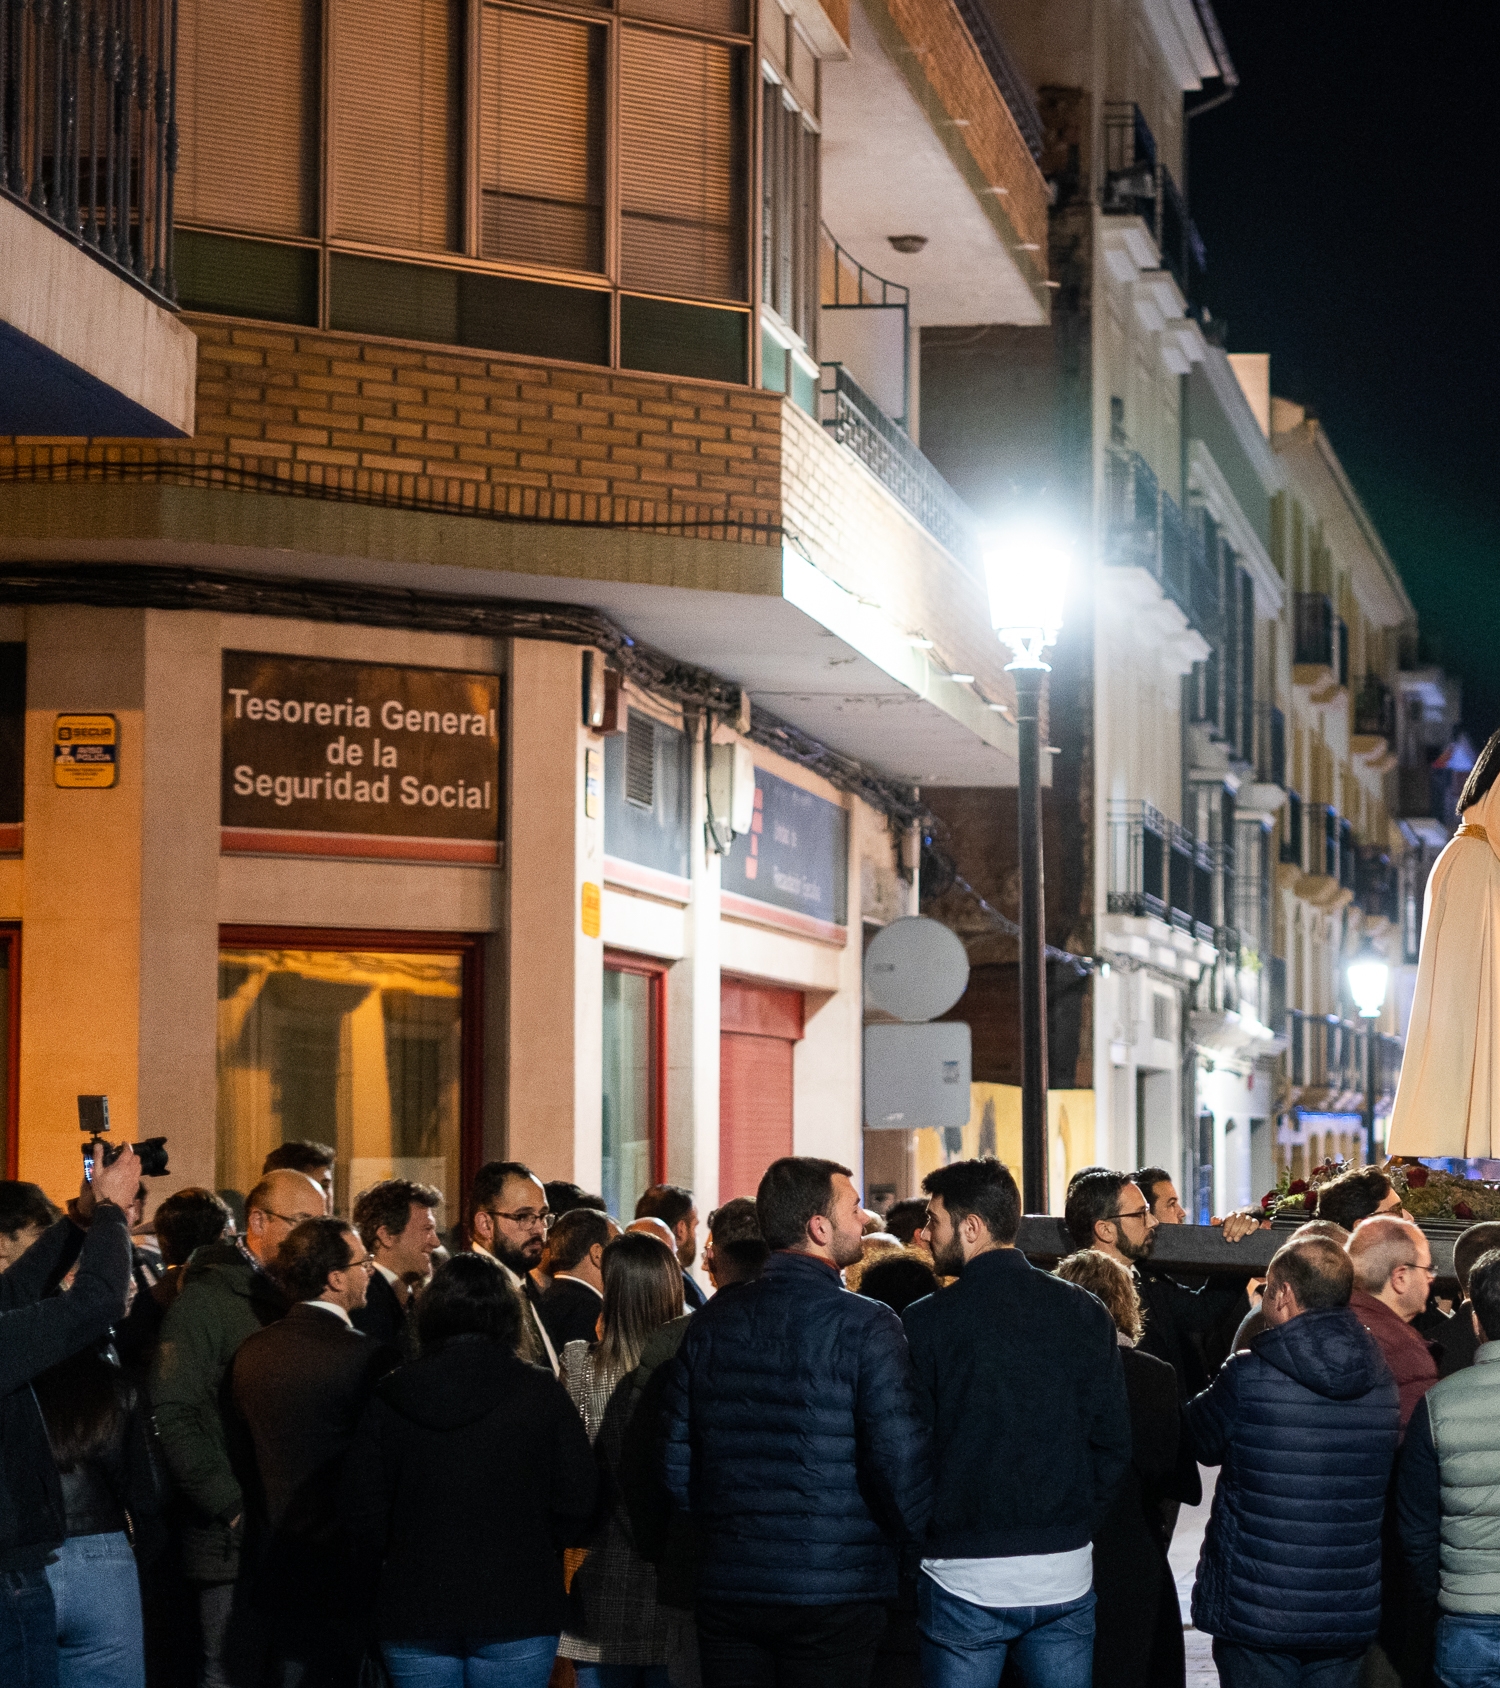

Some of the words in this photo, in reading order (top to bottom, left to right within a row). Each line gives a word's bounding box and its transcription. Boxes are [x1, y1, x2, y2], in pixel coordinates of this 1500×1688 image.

[228, 688, 371, 728] Tesoreria
[381, 700, 496, 737] General
[326, 736, 364, 766] de
[373, 738, 398, 769] la
[233, 765, 390, 807] Seguridad
[400, 775, 491, 810] Social
